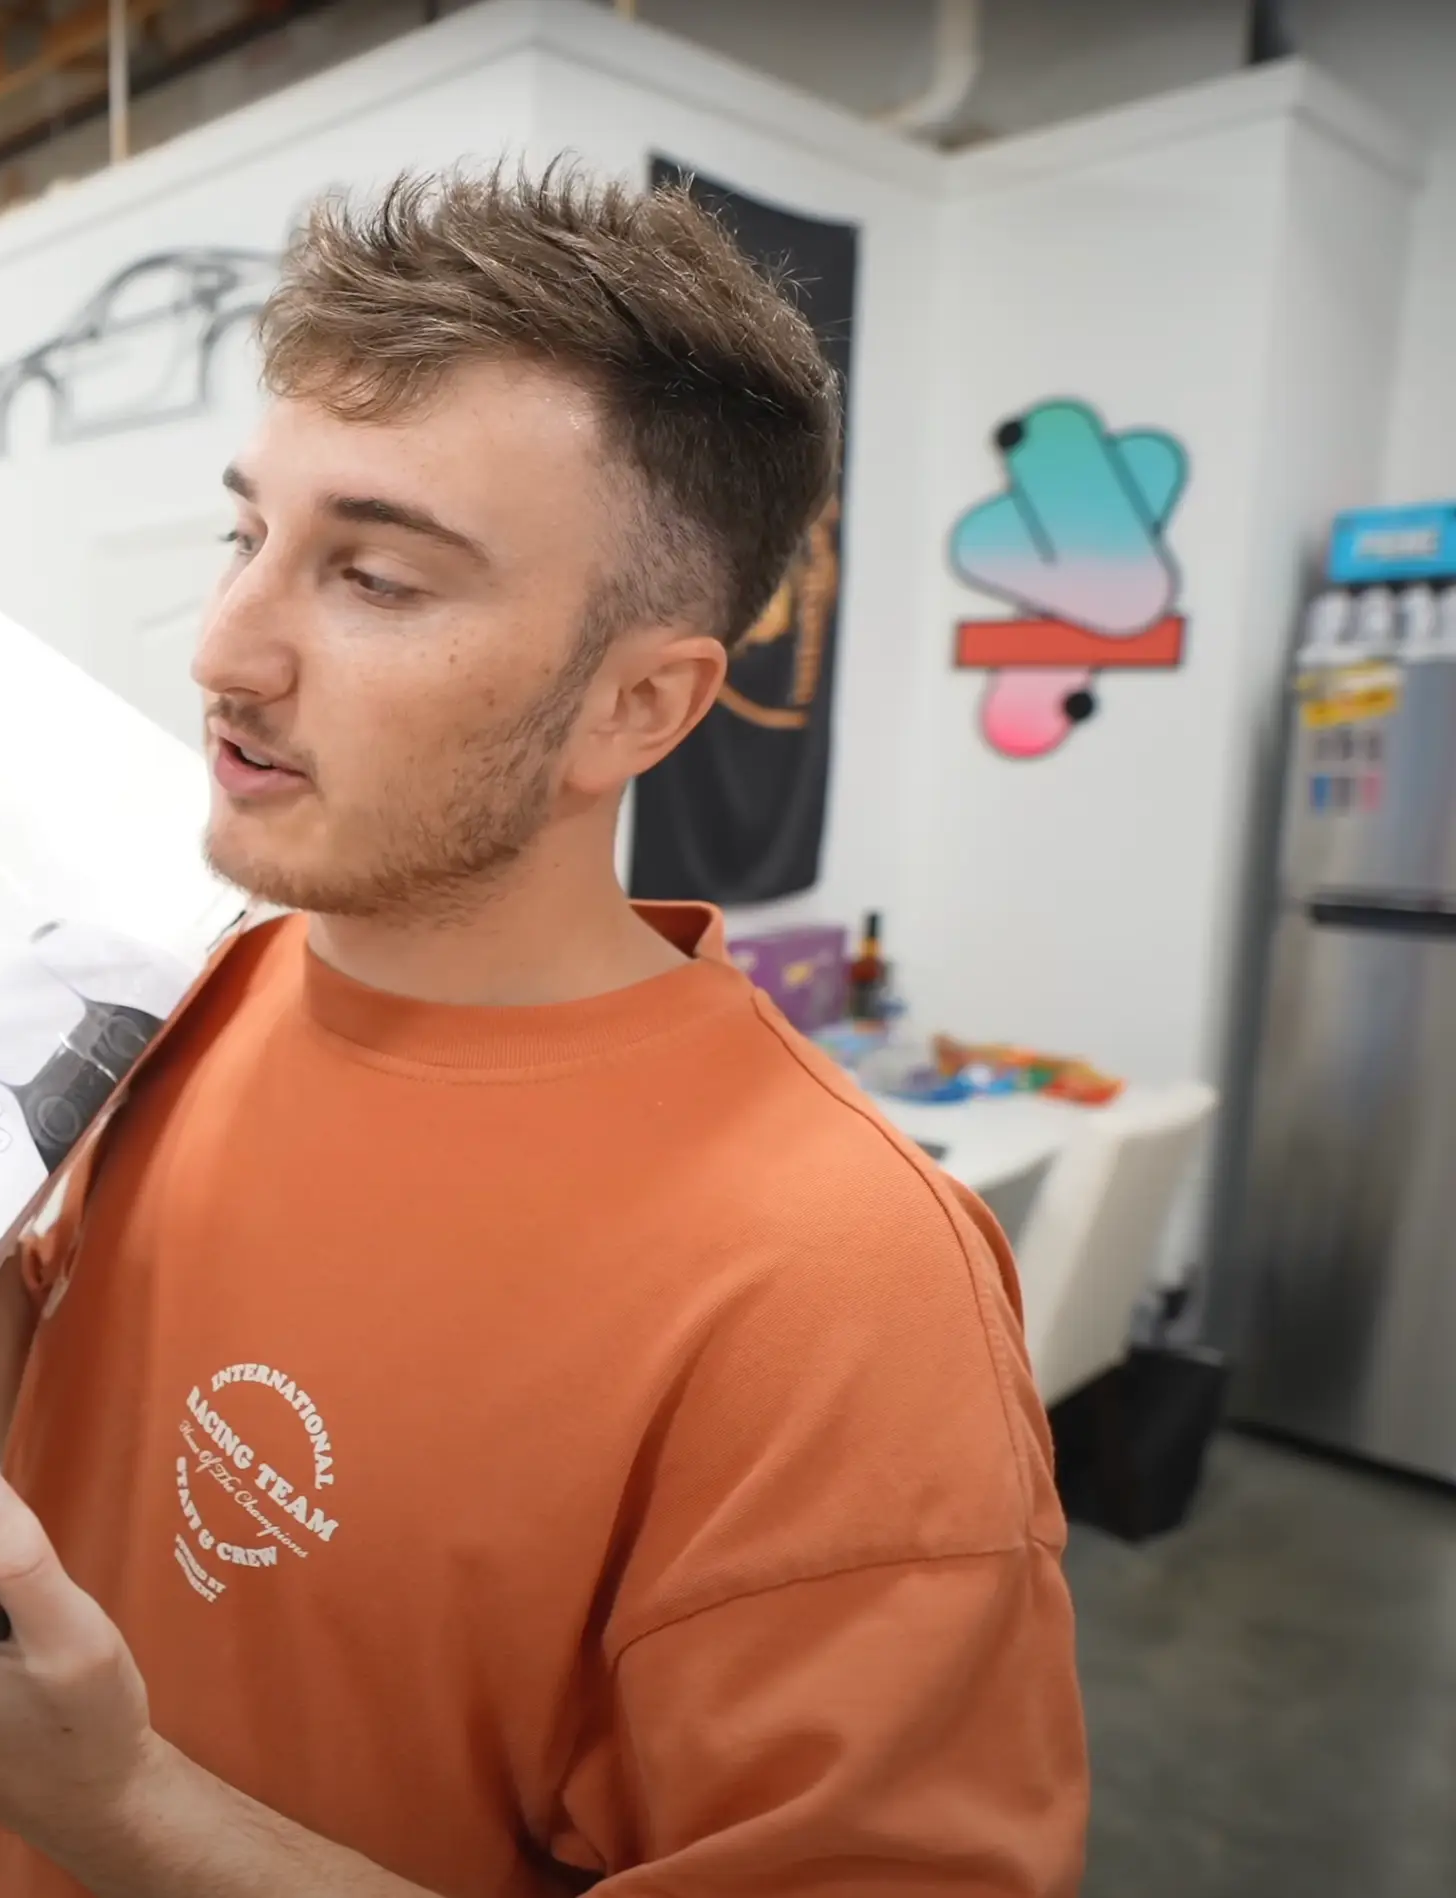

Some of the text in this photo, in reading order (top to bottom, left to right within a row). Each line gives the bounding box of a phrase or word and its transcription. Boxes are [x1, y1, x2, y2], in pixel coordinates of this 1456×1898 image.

[187, 1386, 339, 1542] RACING TEAM
[211, 1363, 334, 1489] INTERNATIONAL
[216, 1542, 277, 1567] CREW
